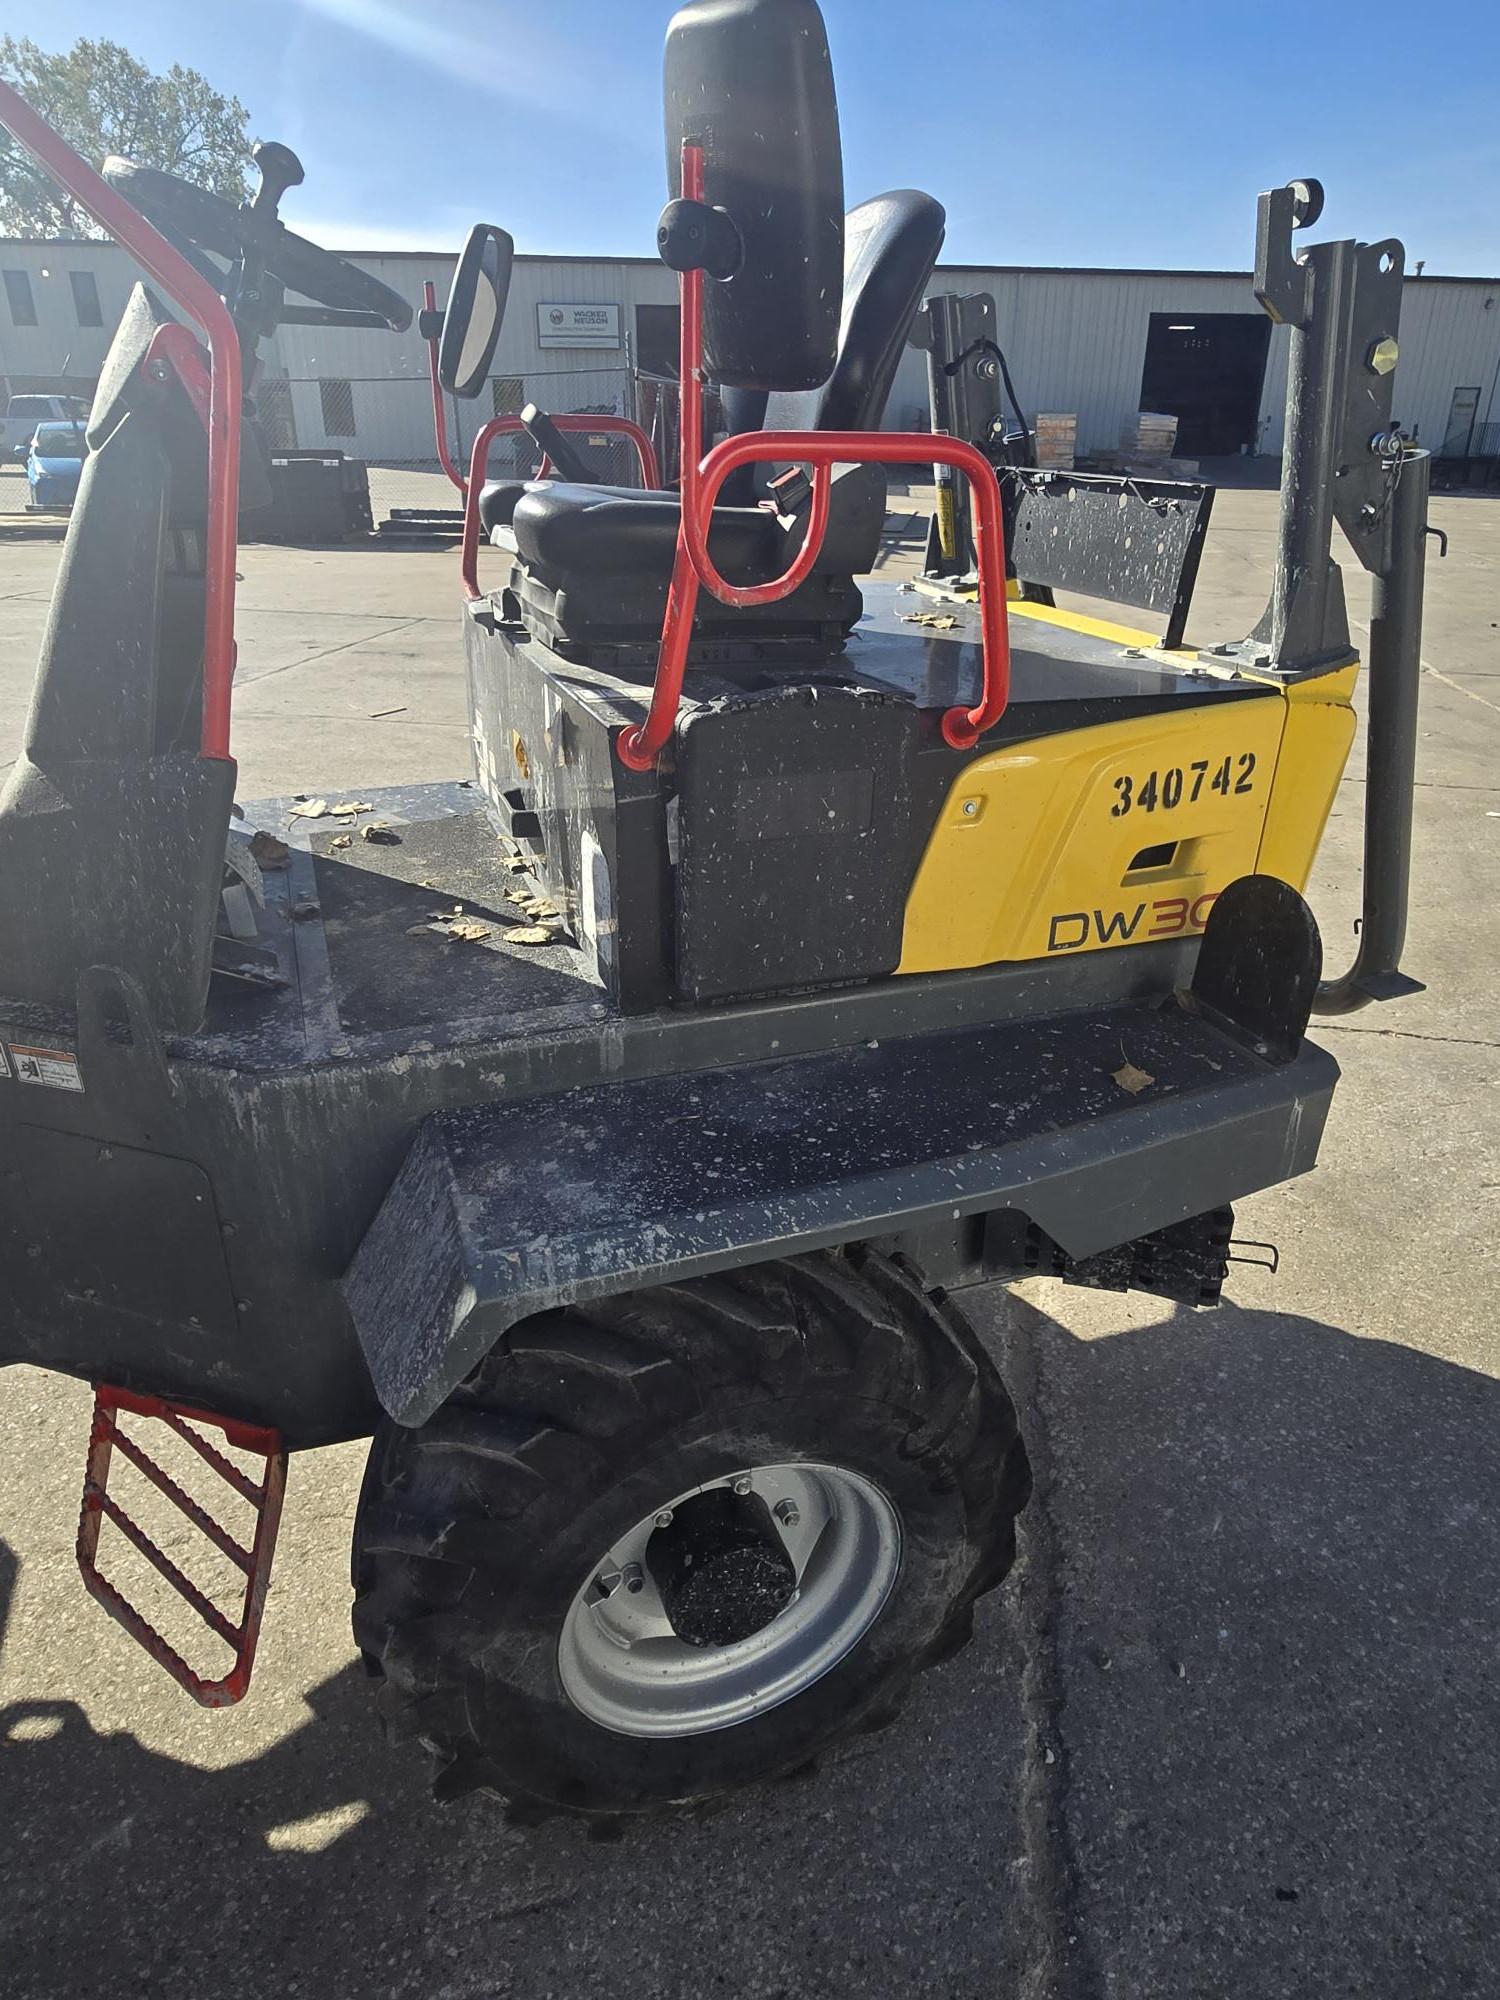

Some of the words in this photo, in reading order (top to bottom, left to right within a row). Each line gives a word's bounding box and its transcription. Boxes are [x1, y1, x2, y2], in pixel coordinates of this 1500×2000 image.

[573, 310, 607, 318] WACKER
[573, 317, 608, 325] NEUSON
[1111, 752, 1256, 818] 340742
